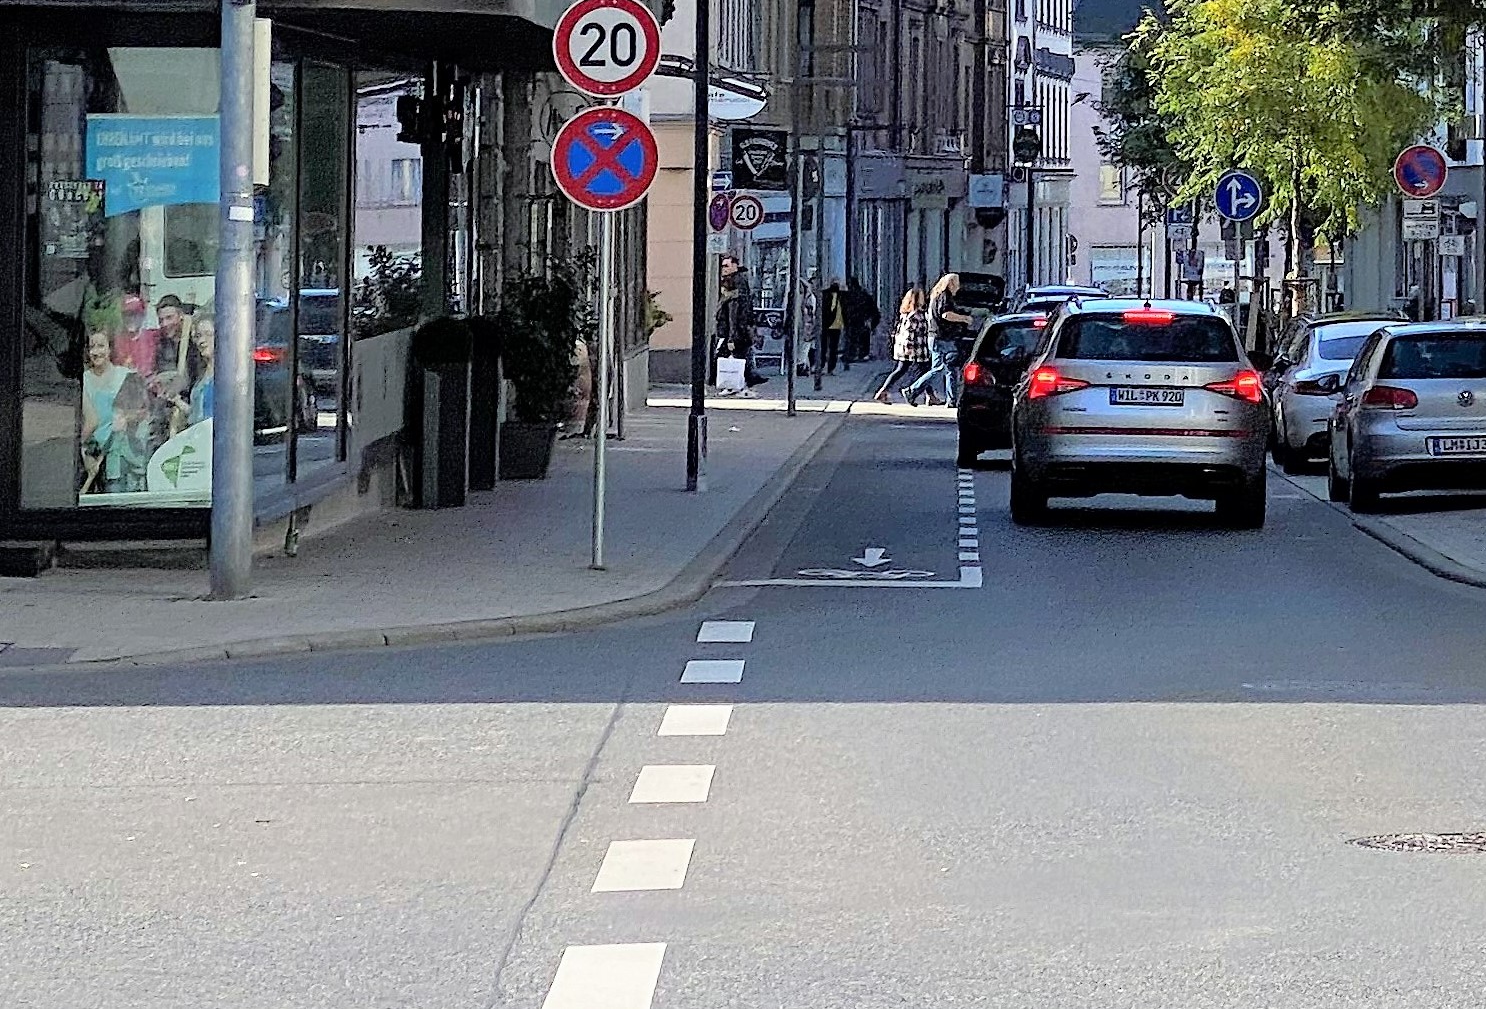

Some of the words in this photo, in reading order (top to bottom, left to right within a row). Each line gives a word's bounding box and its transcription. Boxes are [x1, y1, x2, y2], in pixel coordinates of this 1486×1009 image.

[579, 21, 637, 67] 20
[735, 204, 757, 221] 20
[1117, 389, 1138, 402] WIL
[1145, 390, 1160, 402] PK
[1162, 390, 1182, 403] 920
